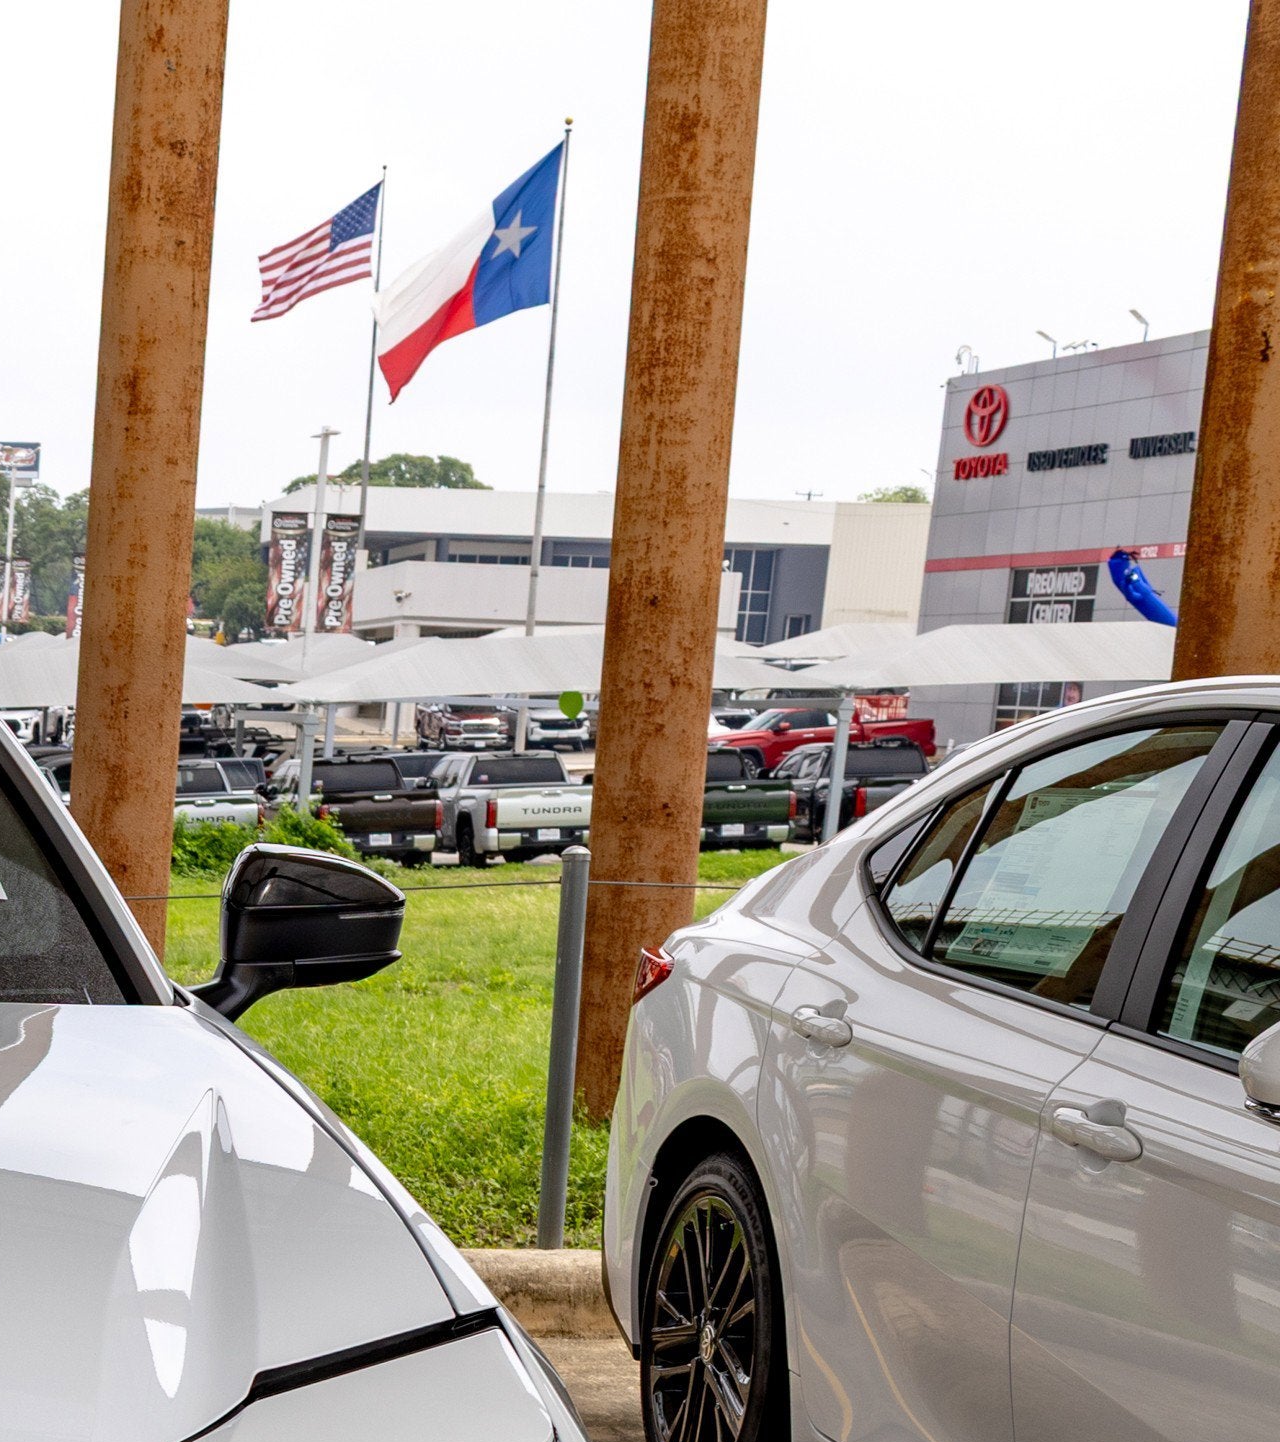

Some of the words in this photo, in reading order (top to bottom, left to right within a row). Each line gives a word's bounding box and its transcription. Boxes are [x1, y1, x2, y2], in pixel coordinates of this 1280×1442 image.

[1027, 450, 1056, 473] USED
[1056, 443, 1109, 469] VEHICLES
[1128, 431, 1196, 460] UNIVERSAL
[953, 453, 1009, 480] TOYOTA
[276, 539, 297, 596] Owned
[326, 541, 348, 598] Owned
[1026, 571, 1085, 595] PREOWNED
[273, 598, 293, 626] Pre
[324, 599, 343, 627] Pre
[1032, 604, 1072, 623] CENTER
[186, 815, 236, 824] UNDRA
[522, 806, 582, 815] TUNDRA
